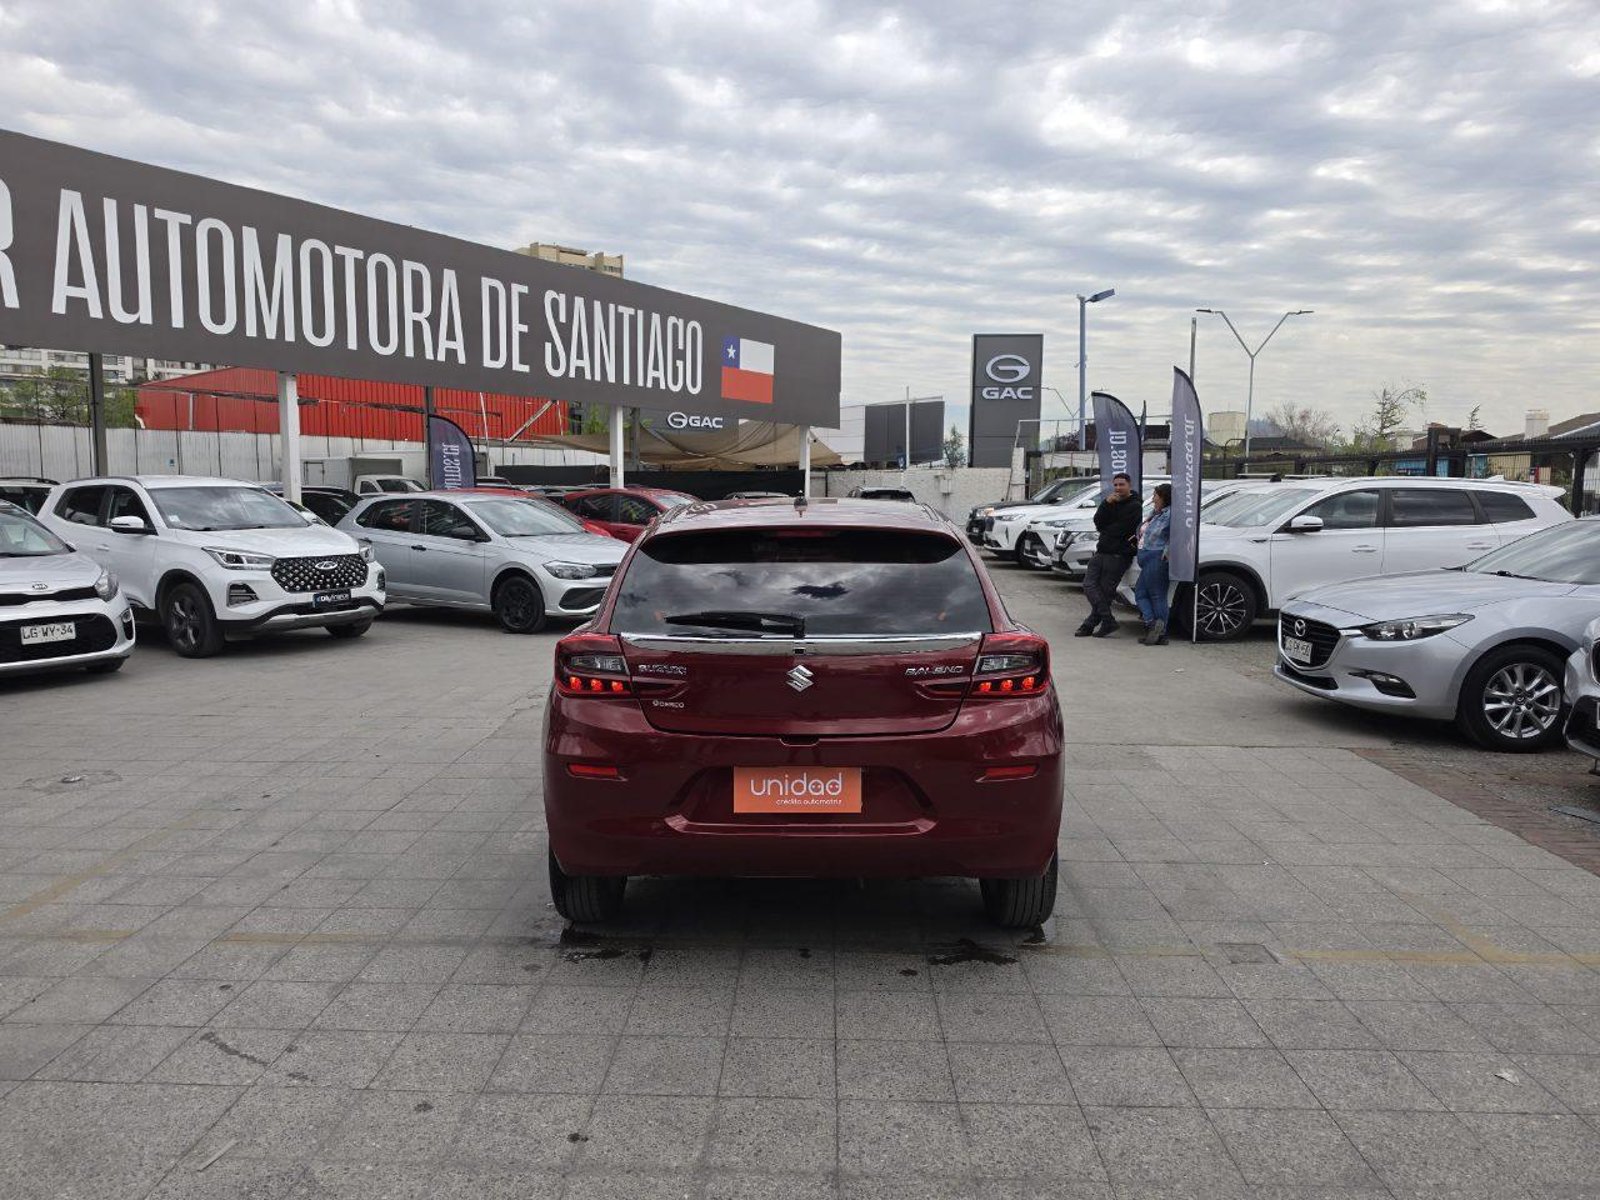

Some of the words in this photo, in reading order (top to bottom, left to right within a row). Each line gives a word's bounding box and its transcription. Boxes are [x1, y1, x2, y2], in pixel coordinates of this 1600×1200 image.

[51, 187, 467, 365] AUTOMOTORA
[480, 276, 531, 374] DE
[544, 289, 703, 395] SANTIAGO
[982, 387, 1033, 400] GAC
[689, 416, 723, 428] GAC
[904, 665, 964, 676] BALENO
[750, 771, 843, 797] unidad
